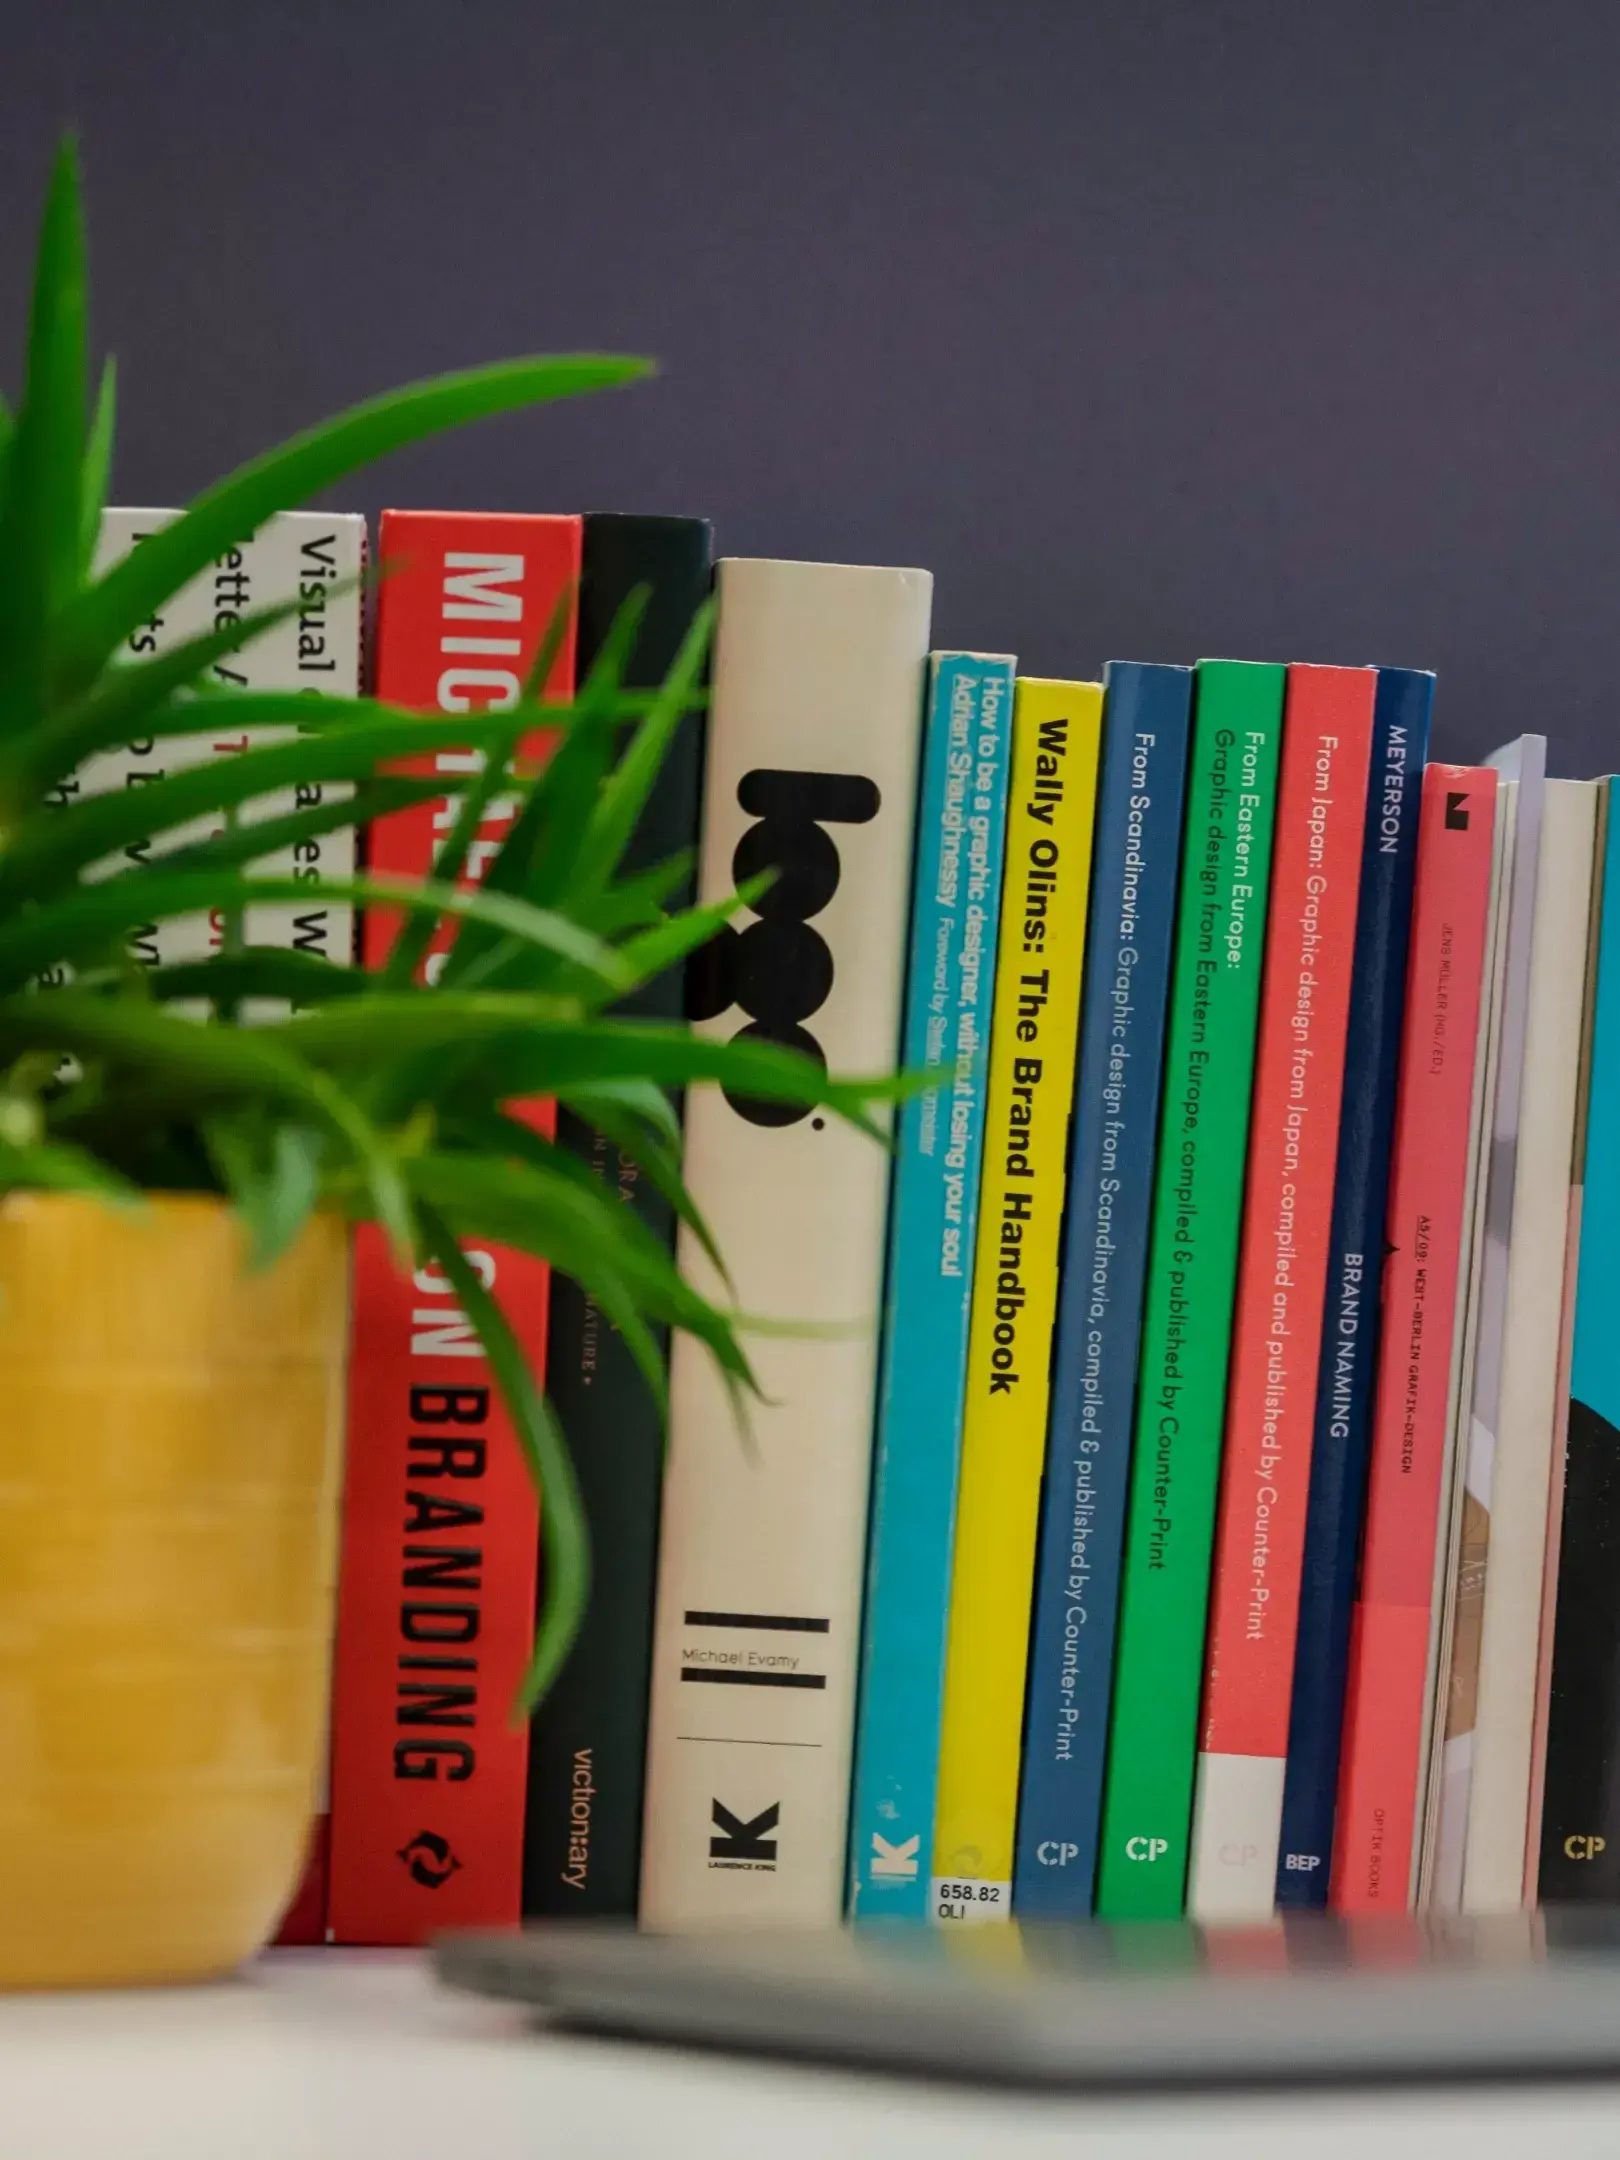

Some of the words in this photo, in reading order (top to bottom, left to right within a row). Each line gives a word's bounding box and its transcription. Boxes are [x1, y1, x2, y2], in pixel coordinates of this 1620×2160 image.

[952, 673, 977, 747] Adrian
[979, 675, 1005, 730] How
[975, 762, 998, 792] be
[977, 733, 1000, 757] to
[1027, 718, 1069, 826] Wally
[1132, 733, 1156, 789] From
[1207, 728, 1236, 820] Graphic
[1241, 731, 1265, 787] From
[1314, 735, 1339, 792] From
[974, 797, 991, 811] a
[1379, 724, 1408, 853] MEYERSON
[935, 752, 972, 908] Shaughnessy
[967, 816, 992, 901] graphic
[1199, 825, 1228, 896] design
[1234, 794, 1260, 877] Eastern
[1306, 796, 1334, 869] Japan:
[1023, 839, 1059, 953] Olins:
[1120, 795, 1151, 941] Scandinavia:
[957, 903, 988, 1007] designer,
[1198, 902, 1223, 953] from
[1223, 884, 1253, 969] Europe:
[1298, 875, 1328, 966] Graphic
[1440, 923, 1453, 955] JENS
[1017, 968, 1050, 1043] The
[1110, 946, 1139, 1038] Graphic
[1191, 959, 1218, 1044] Eastern
[1290, 971, 1319, 1042] design
[954, 1012, 980, 1096] without
[1102, 1043, 1131, 1114] design
[1290, 1048, 1314, 1099] from
[1007, 1057, 1043, 1178] Brand
[1181, 1050, 1210, 1134] Europe,
[944, 1099, 974, 1168] losing
[1101, 1120, 1126, 1172] from
[1281, 1104, 1309, 1177] Japan,
[941, 1172, 965, 1225] your
[1173, 1140, 1199, 1244] compiled
[940, 1227, 963, 1277] soul
[1087, 1177, 1121, 1324] Scandinavia,
[1172, 1249, 1194, 1265] &
[1273, 1183, 1297, 1287] compiled
[1414, 1215, 1431, 1263] A5/09:
[989, 1192, 1033, 1395] Handbook
[1163, 1270, 1190, 1379] published
[1271, 1292, 1291, 1335] and
[1339, 1253, 1364, 1335] BRAND
[1410, 1268, 1427, 1360] WEST-BERLIN
[1079, 1330, 1104, 1434] compiled
[1156, 1385, 1183, 1411] by
[1261, 1340, 1288, 1449] published
[1330, 1341, 1356, 1438] NAMING
[1079, 1440, 1100, 1454] &
[1401, 1364, 1419, 1474] GRAFIK-DESIGN
[1148, 1416, 1180, 1570] Counter-Print
[1254, 1455, 1281, 1480] by
[1070, 1460, 1097, 1569] published
[395, 1383, 490, 1783] BRANDING
[1063, 1575, 1091, 1600] by
[1246, 1486, 1278, 1639] Counter-Print
[682, 1649, 742, 1664] Michael
[748, 1652, 800, 1670] Evamy
[1055, 1606, 1088, 1761] Counter-Print
[1036, 1841, 1079, 1866] CP
[1125, 1836, 1169, 1862] CP
[1286, 1854, 1320, 1871] BEP
[1371, 1808, 1386, 1850] OPTIK
[1564, 1835, 1606, 1860] CP
[708, 1861, 752, 1871] LAURENCE
[754, 1863, 776, 1872] KING
[940, 1884, 1000, 1902] 658.82
[1367, 1855, 1382, 1898] BOOKS
[938, 1903, 965, 1919] OLI
